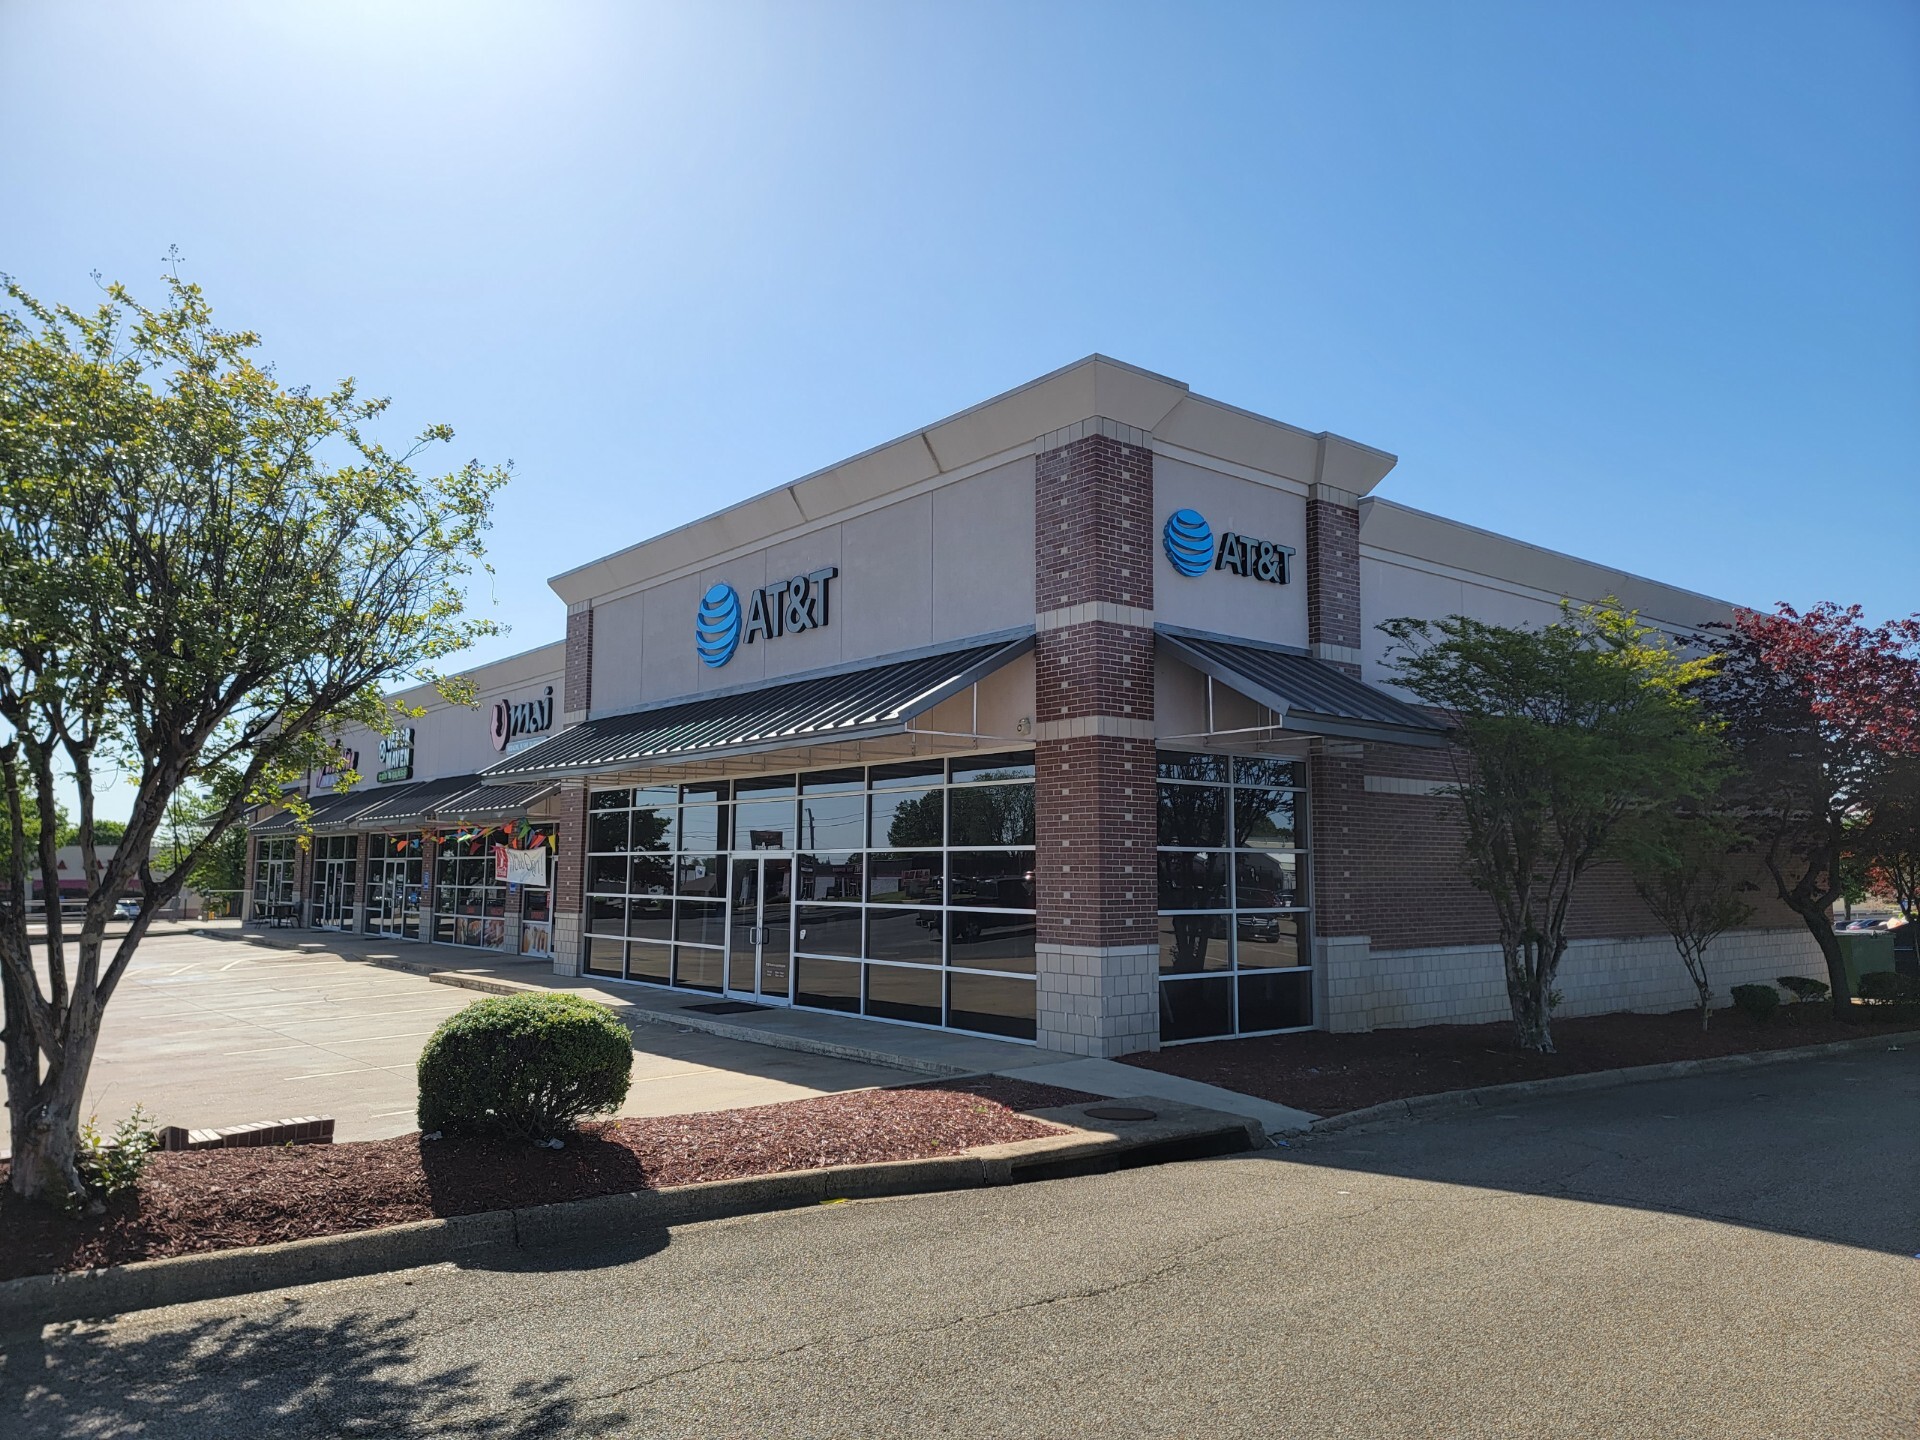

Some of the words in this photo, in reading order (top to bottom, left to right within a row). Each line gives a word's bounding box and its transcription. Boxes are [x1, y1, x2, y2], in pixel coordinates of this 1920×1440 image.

[1215, 531, 1297, 585] AT&T
[743, 567, 838, 644] AT&T
[386, 747, 414, 770] MAVEN
